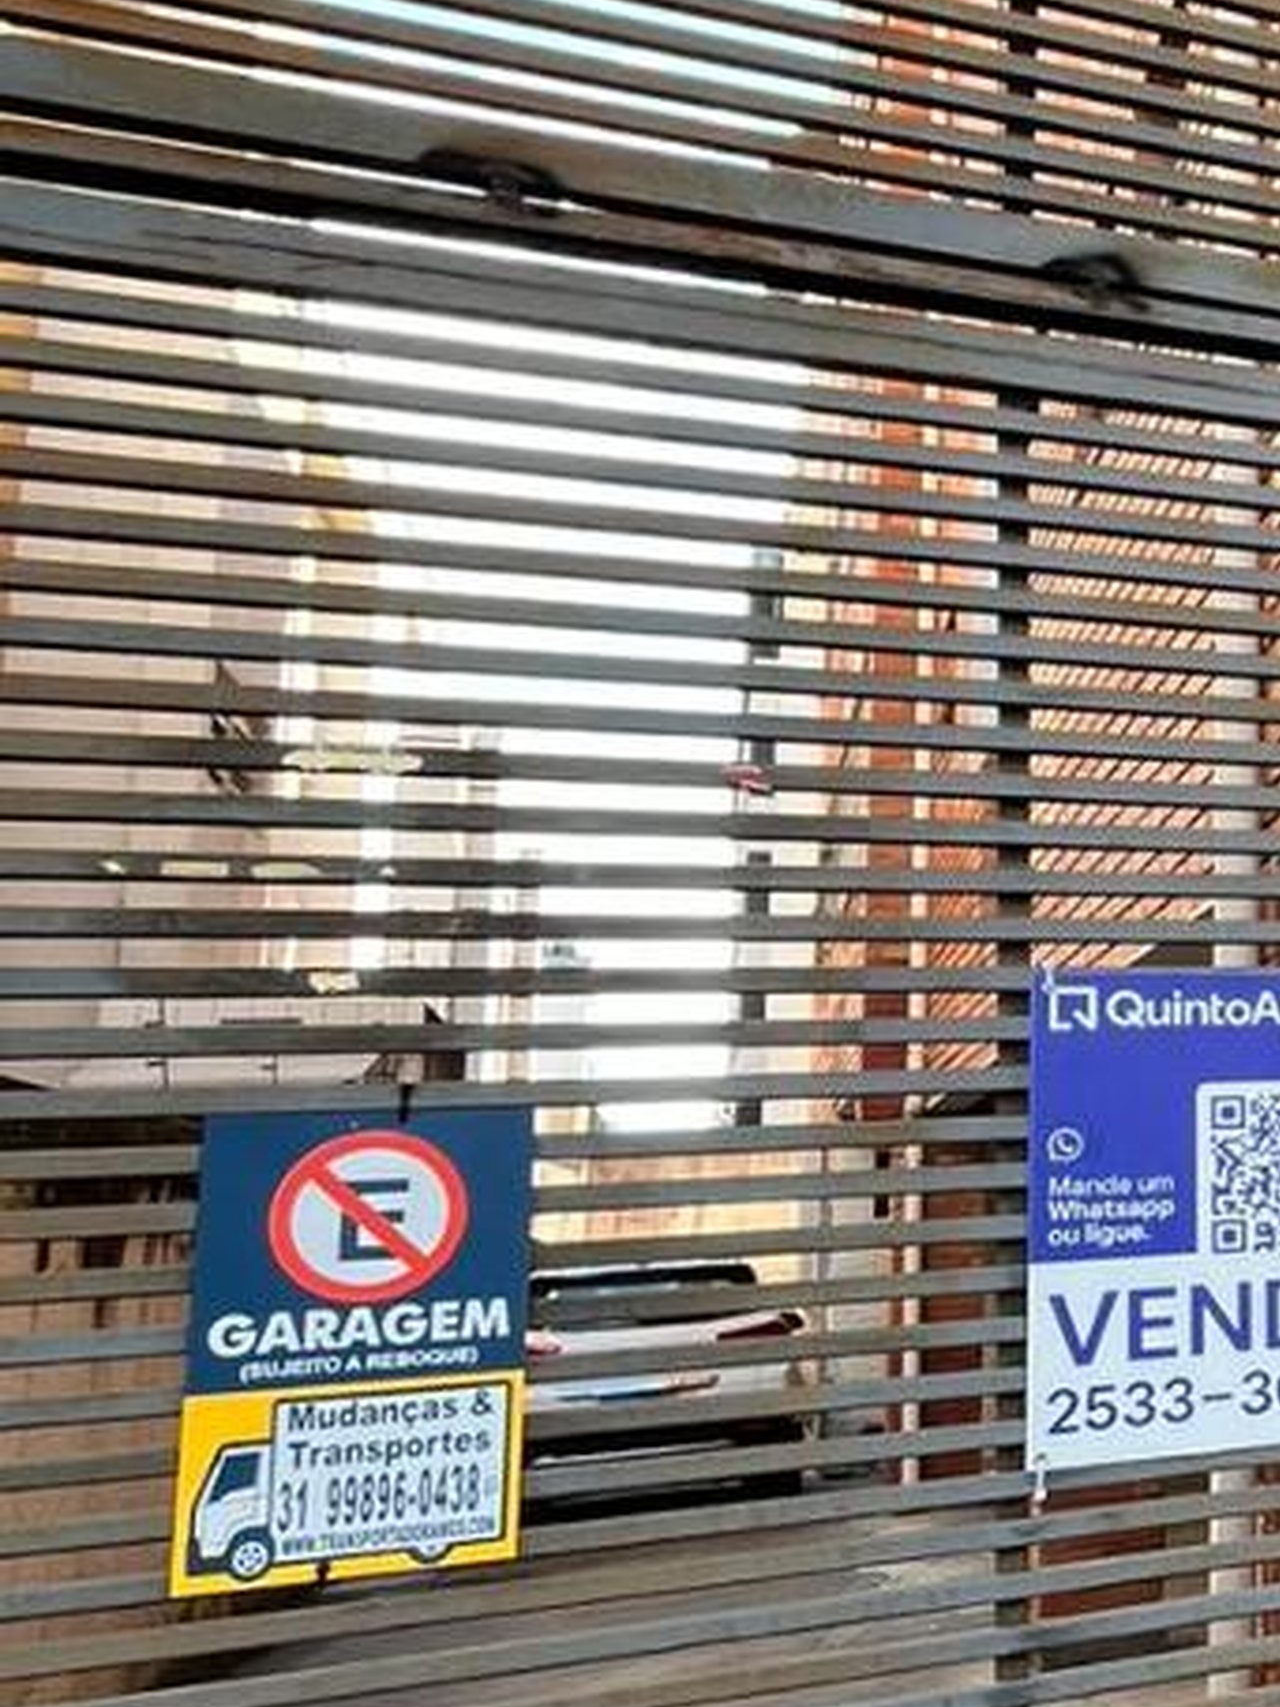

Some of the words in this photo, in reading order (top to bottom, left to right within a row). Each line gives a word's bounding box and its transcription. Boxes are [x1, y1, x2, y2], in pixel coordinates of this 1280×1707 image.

[1049, 1175, 1133, 1195] Mande
[1137, 1175, 1175, 1193] um
[1048, 1199, 1176, 1221] Whatsapp
[1048, 1229, 1080, 1245] ou
[1084, 1223, 1152, 1248] ligue.
[207, 1297, 511, 1358] GARAGEM
[239, 1355, 342, 1384] (SUJEITO
[345, 1353, 361, 1372] A
[366, 1345, 479, 1370] REBOQUE)
[288, 1396, 458, 1431] Mudanças
[470, 1389, 493, 1416] &
[288, 1430, 491, 1468] Transportes
[277, 1480, 308, 1532] 31
